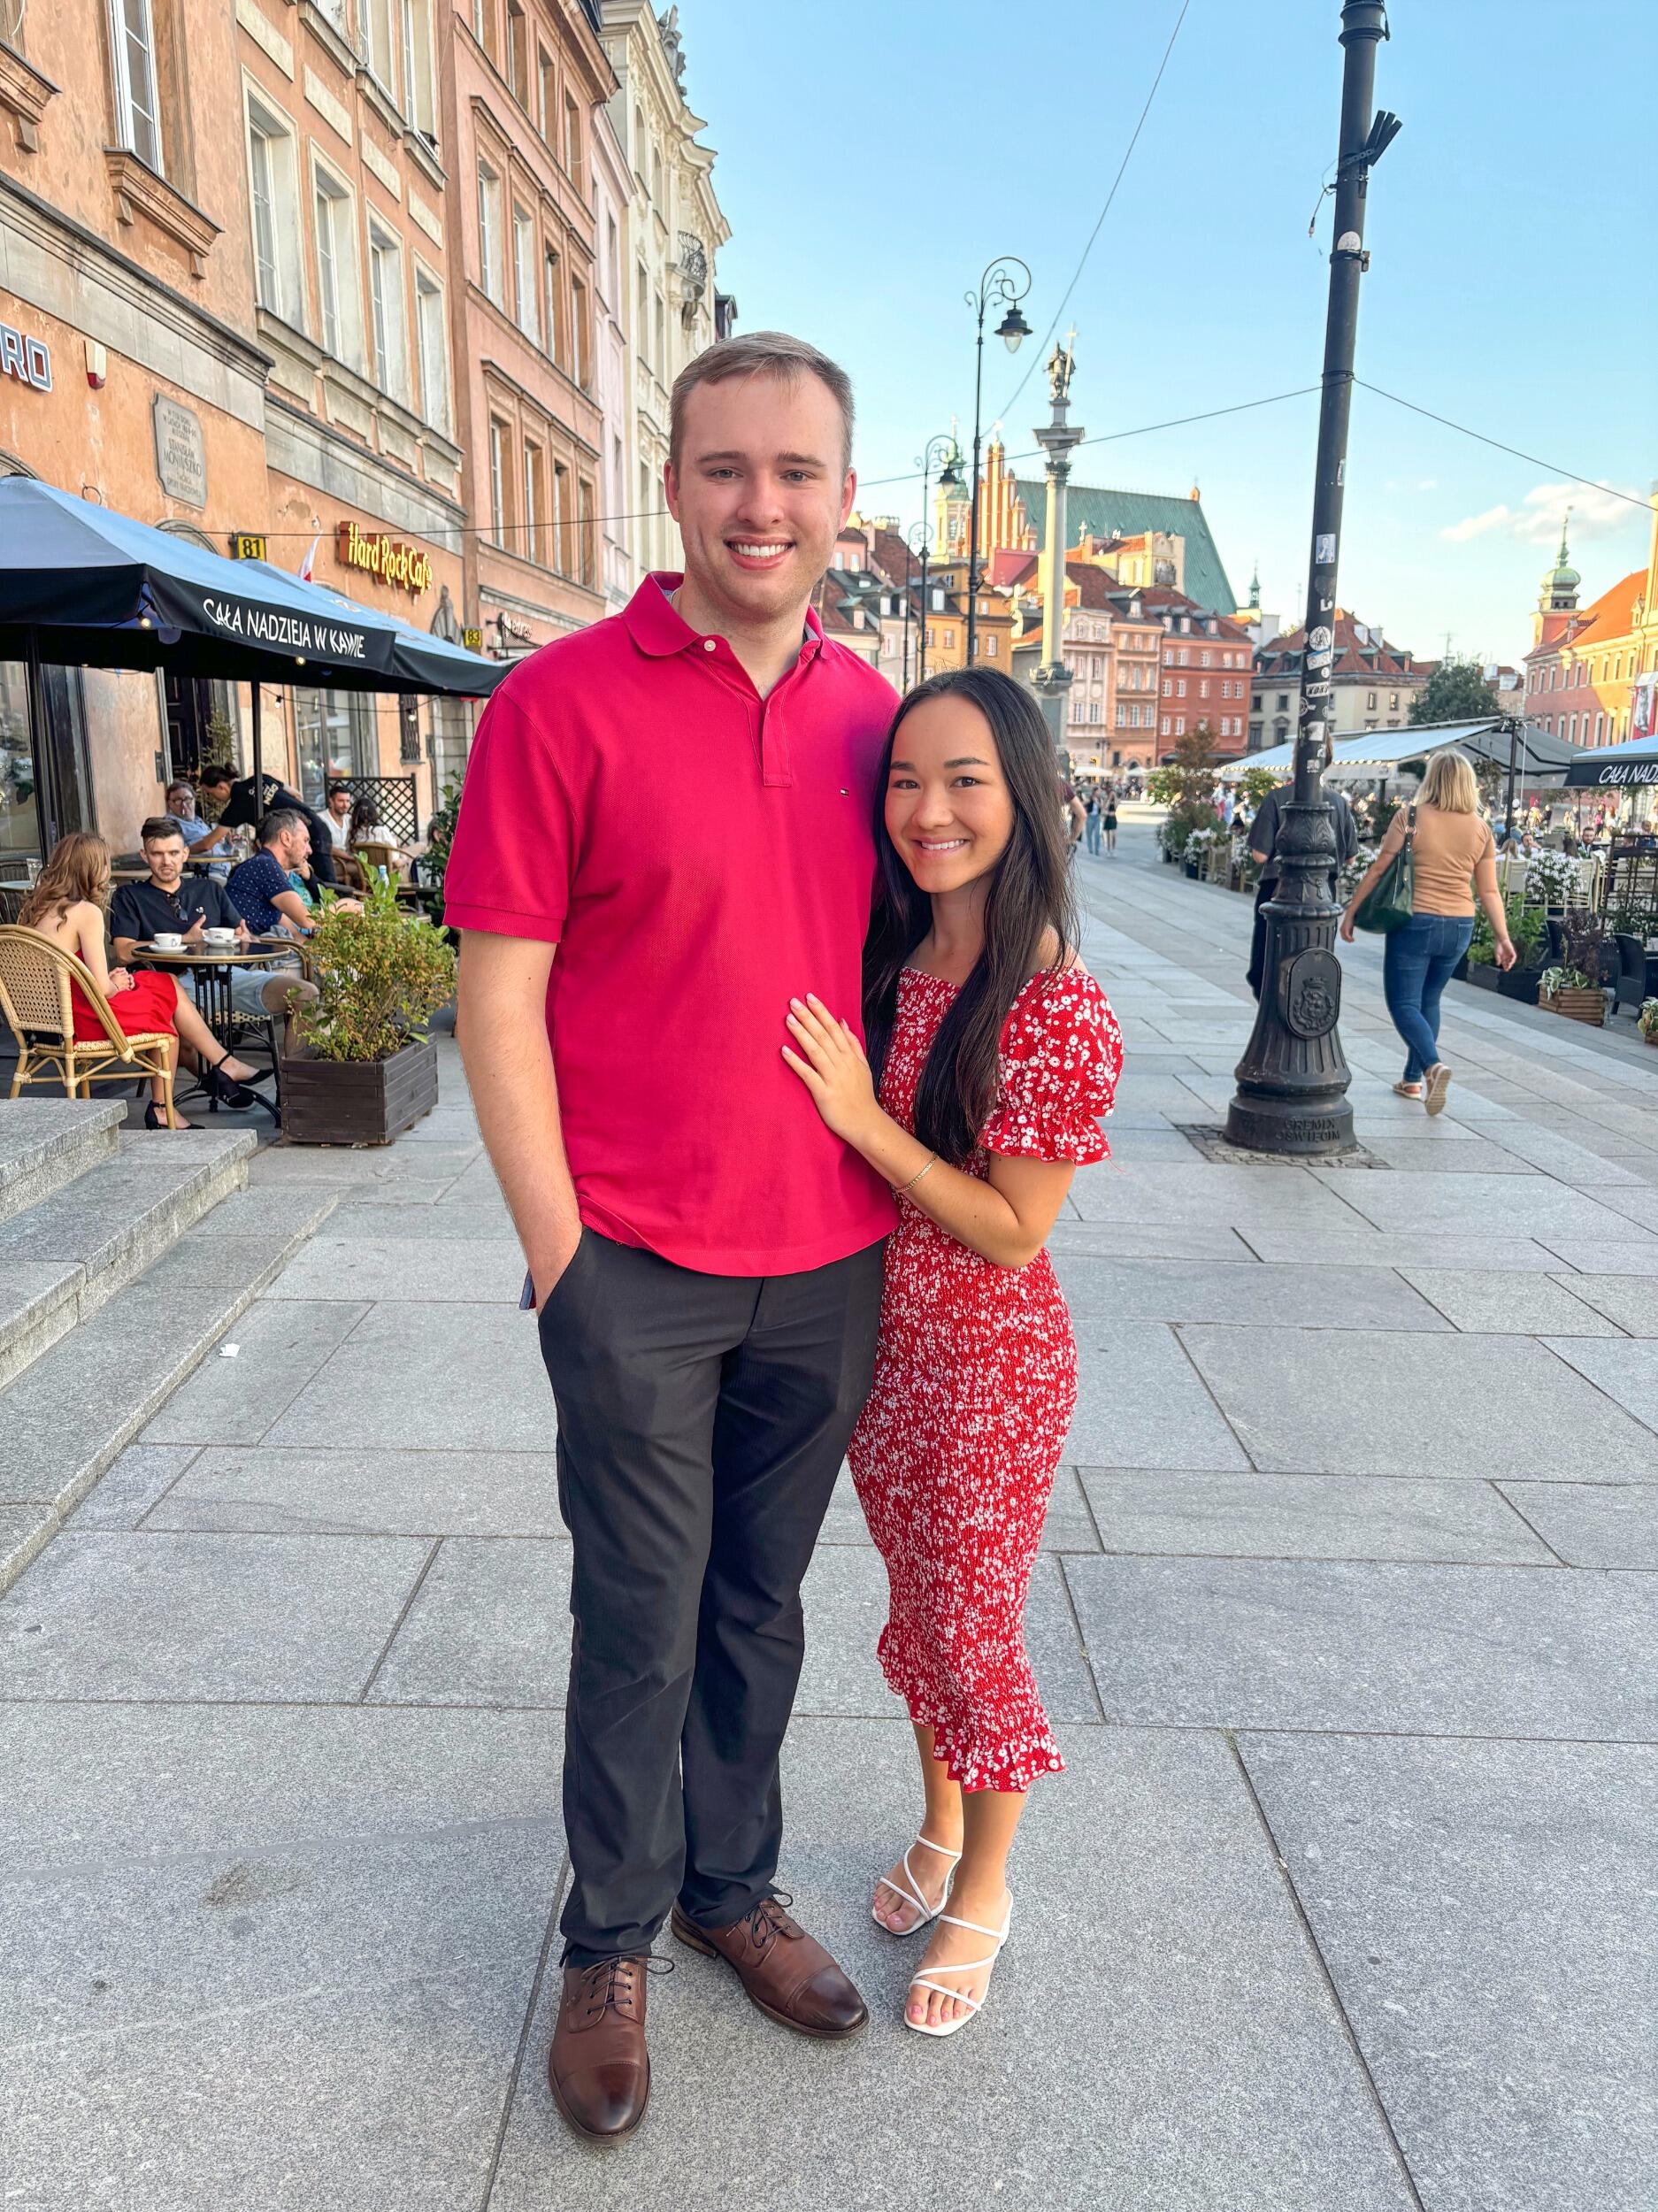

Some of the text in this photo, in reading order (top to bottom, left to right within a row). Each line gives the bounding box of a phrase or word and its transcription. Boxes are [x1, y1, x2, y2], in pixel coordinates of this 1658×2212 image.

[242, 538, 260, 558] 81
[348, 522, 380, 572] Hard
[381, 534, 409, 590] Rock
[203, 598, 365, 658] CAŁA NADZIEJA W KAWIE
[467, 630, 480, 642] 83
[1599, 764, 1629, 784] CAŁA
